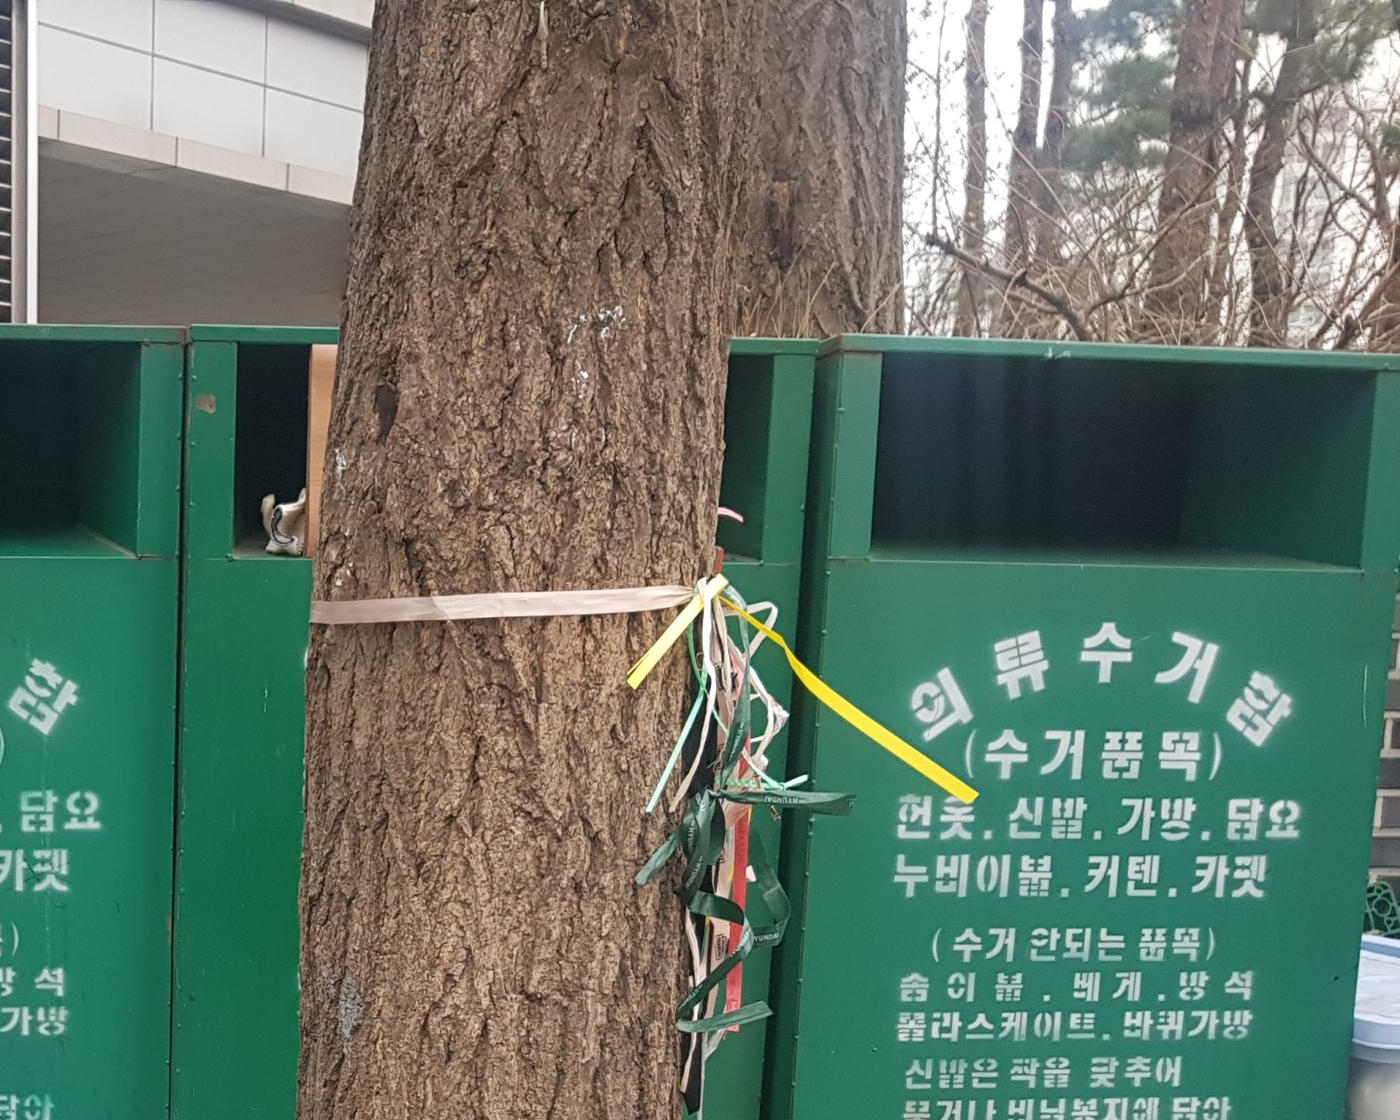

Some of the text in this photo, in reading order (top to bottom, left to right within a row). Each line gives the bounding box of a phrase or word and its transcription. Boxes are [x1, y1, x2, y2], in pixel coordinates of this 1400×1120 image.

[911, 622, 1294, 747] 의류수거함
[21, 791, 101, 832] 담요
[1227, 798, 1301, 841] 담요
[753, 932, 779, 943] YUNDAI
[1030, 928, 1125, 961] 안되는
[1123, 1010, 1253, 1040] 바퀴가방
[906, 1056, 1182, 1089] 신발은 짝을 맞추어
